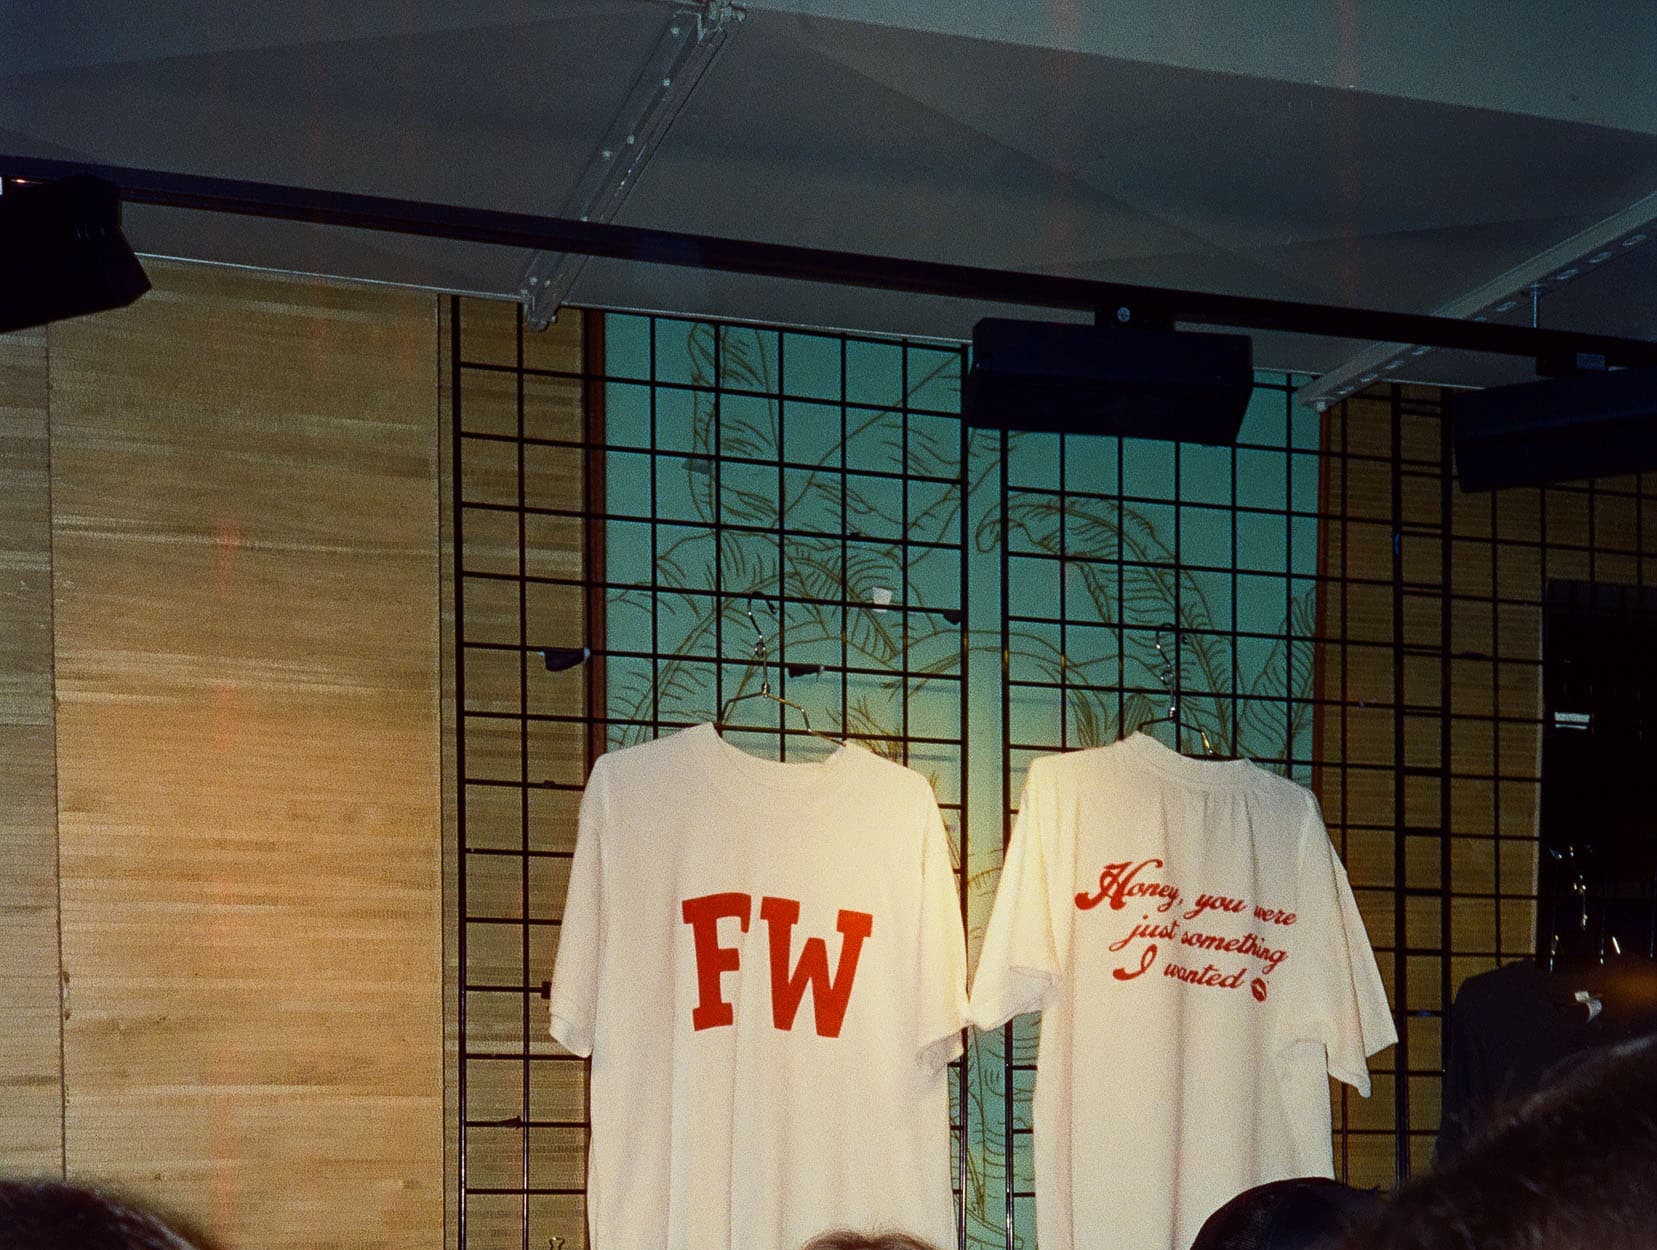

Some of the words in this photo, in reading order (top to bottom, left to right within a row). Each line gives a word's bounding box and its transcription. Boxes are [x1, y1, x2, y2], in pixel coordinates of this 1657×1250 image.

[1074, 858, 1184, 912] Honey,
[1183, 893, 1248, 919] you
[1253, 904, 1297, 926] were
[681, 891, 874, 1039] FW
[1109, 914, 1178, 952] just
[1181, 932, 1288, 975] something
[1112, 943, 1158, 981] I
[1163, 962, 1248, 989] wanted
